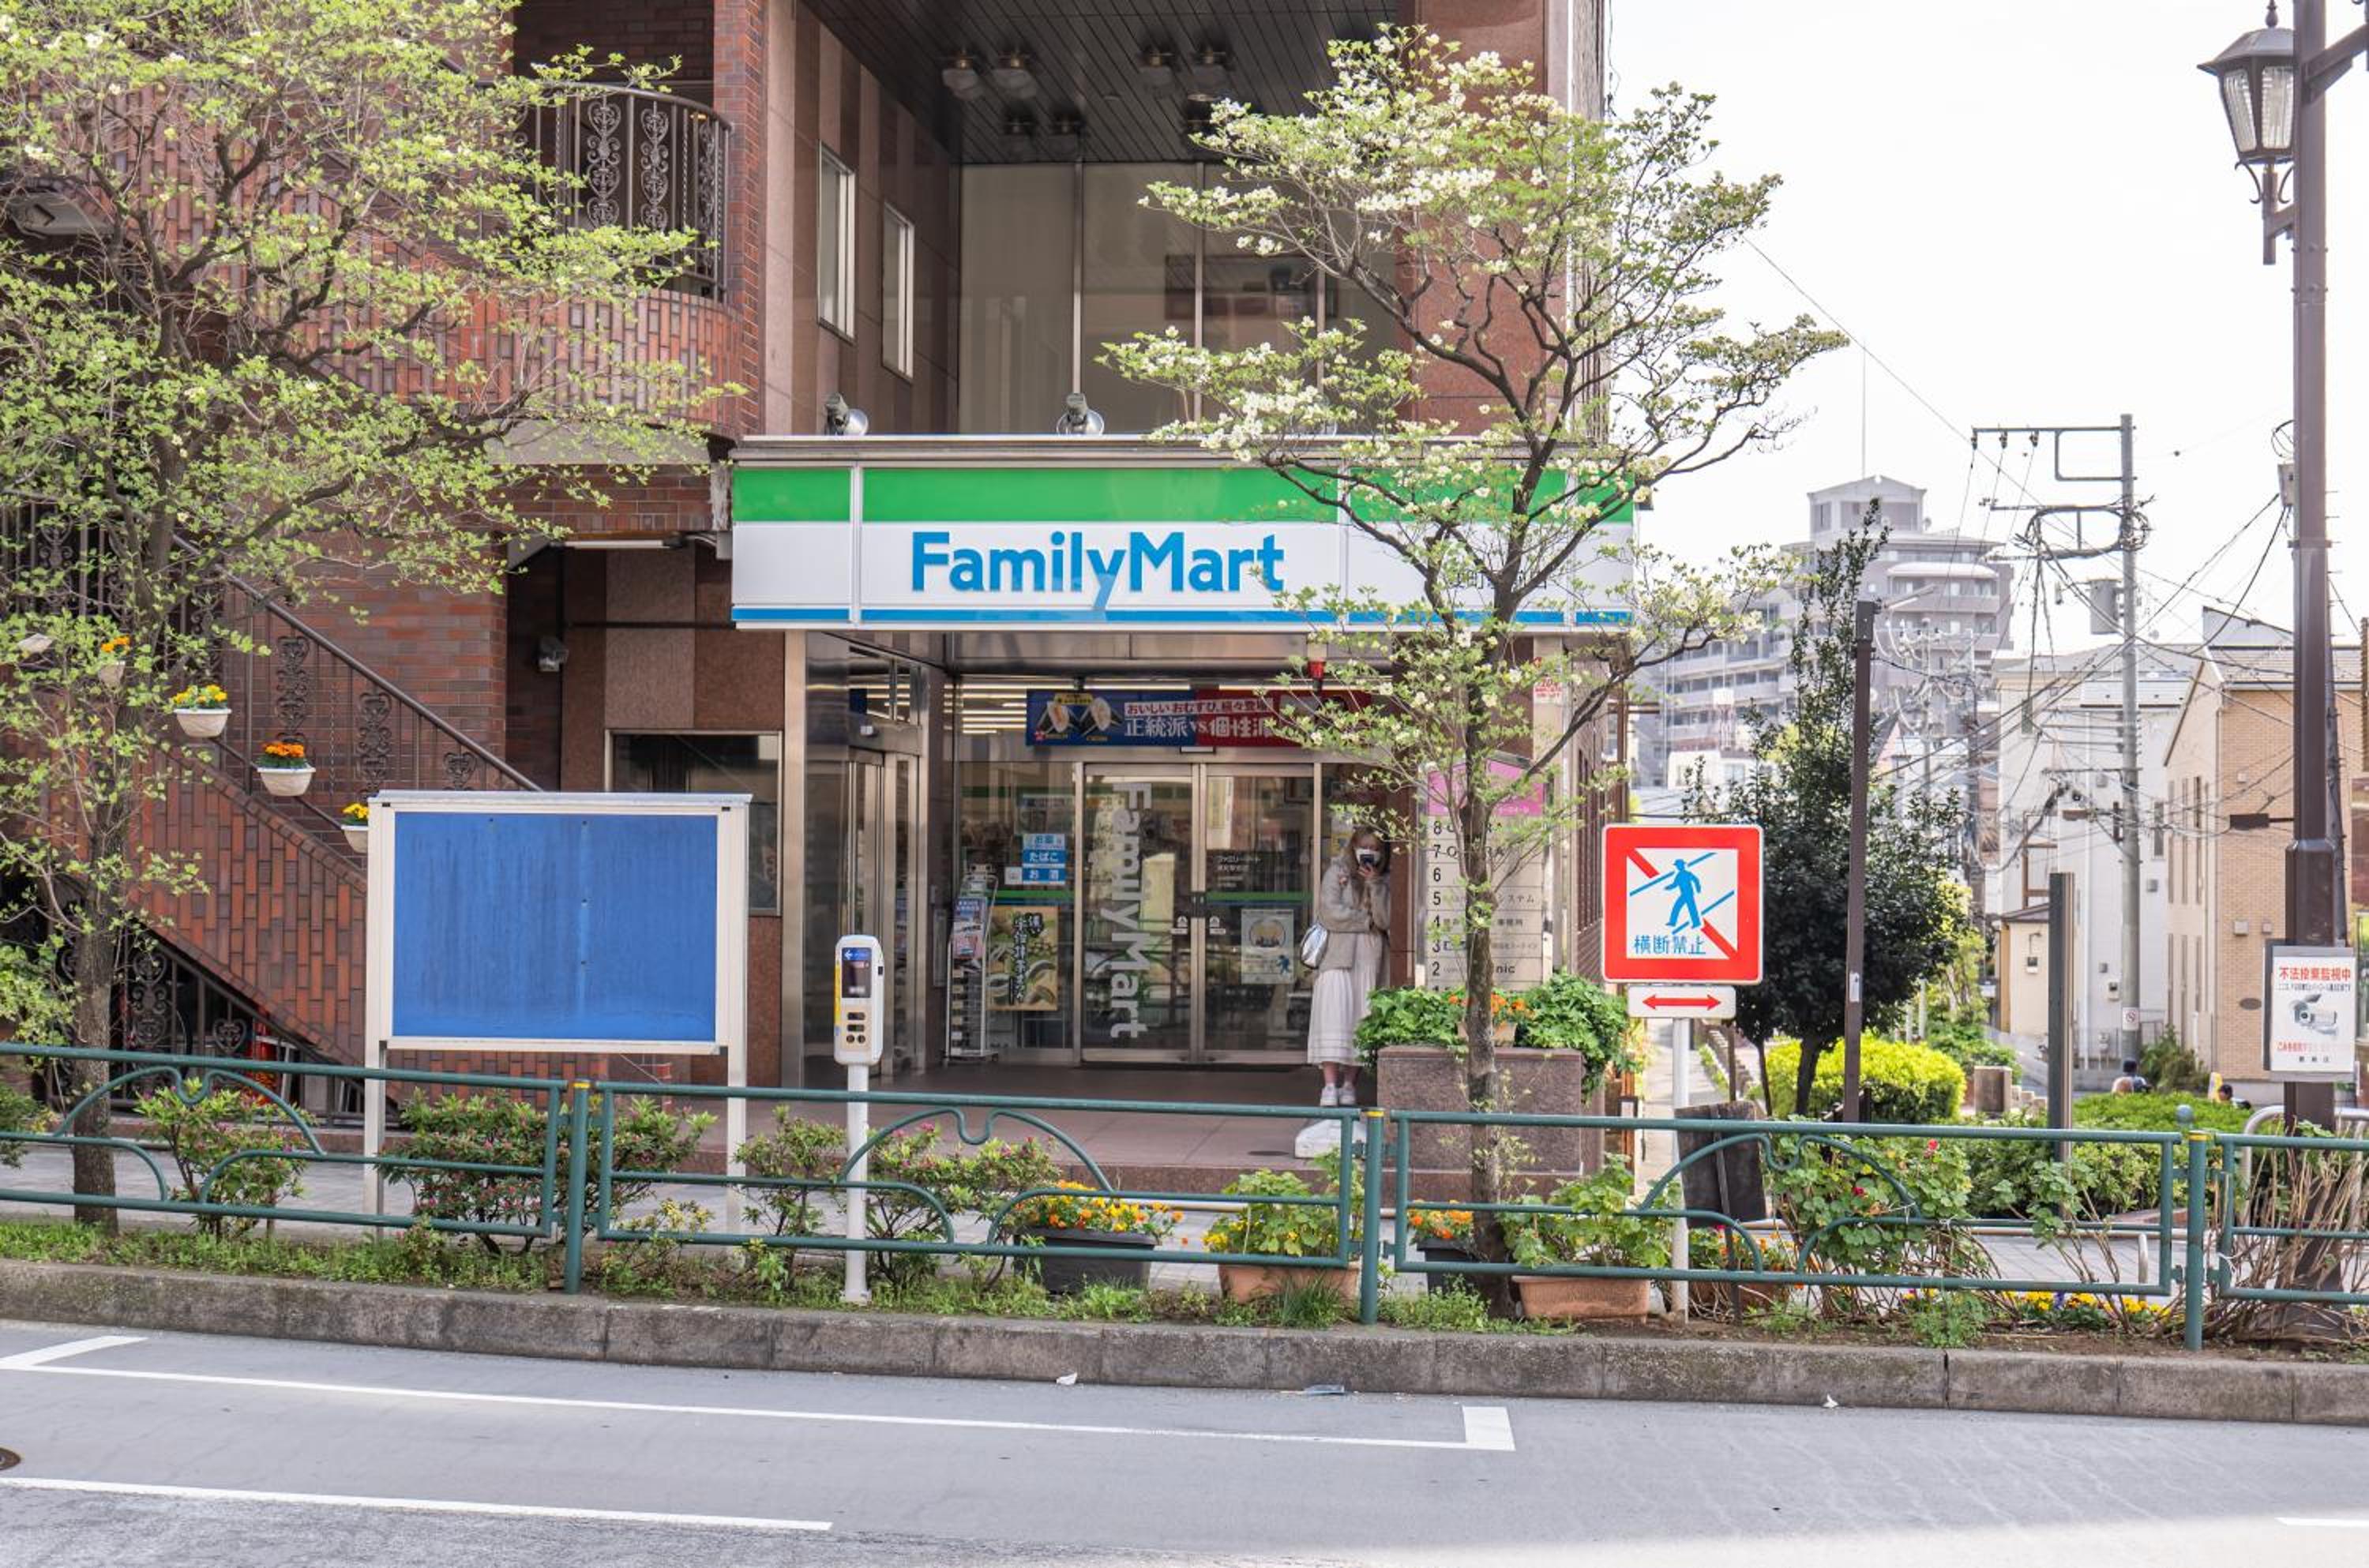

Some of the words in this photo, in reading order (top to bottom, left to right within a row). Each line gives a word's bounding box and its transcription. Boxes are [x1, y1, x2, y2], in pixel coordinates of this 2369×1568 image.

[911, 531, 1285, 611] FamilyMart
[1029, 852, 1059, 862] たばこ
[1433, 844, 1441, 859] 7
[1433, 868, 1441, 882] 6
[1432, 891, 1441, 906] 5
[1100, 782, 1152, 1039] FamilyMart
[1634, 935, 1706, 955] 横断禁止
[1432, 961, 1440, 977] 2
